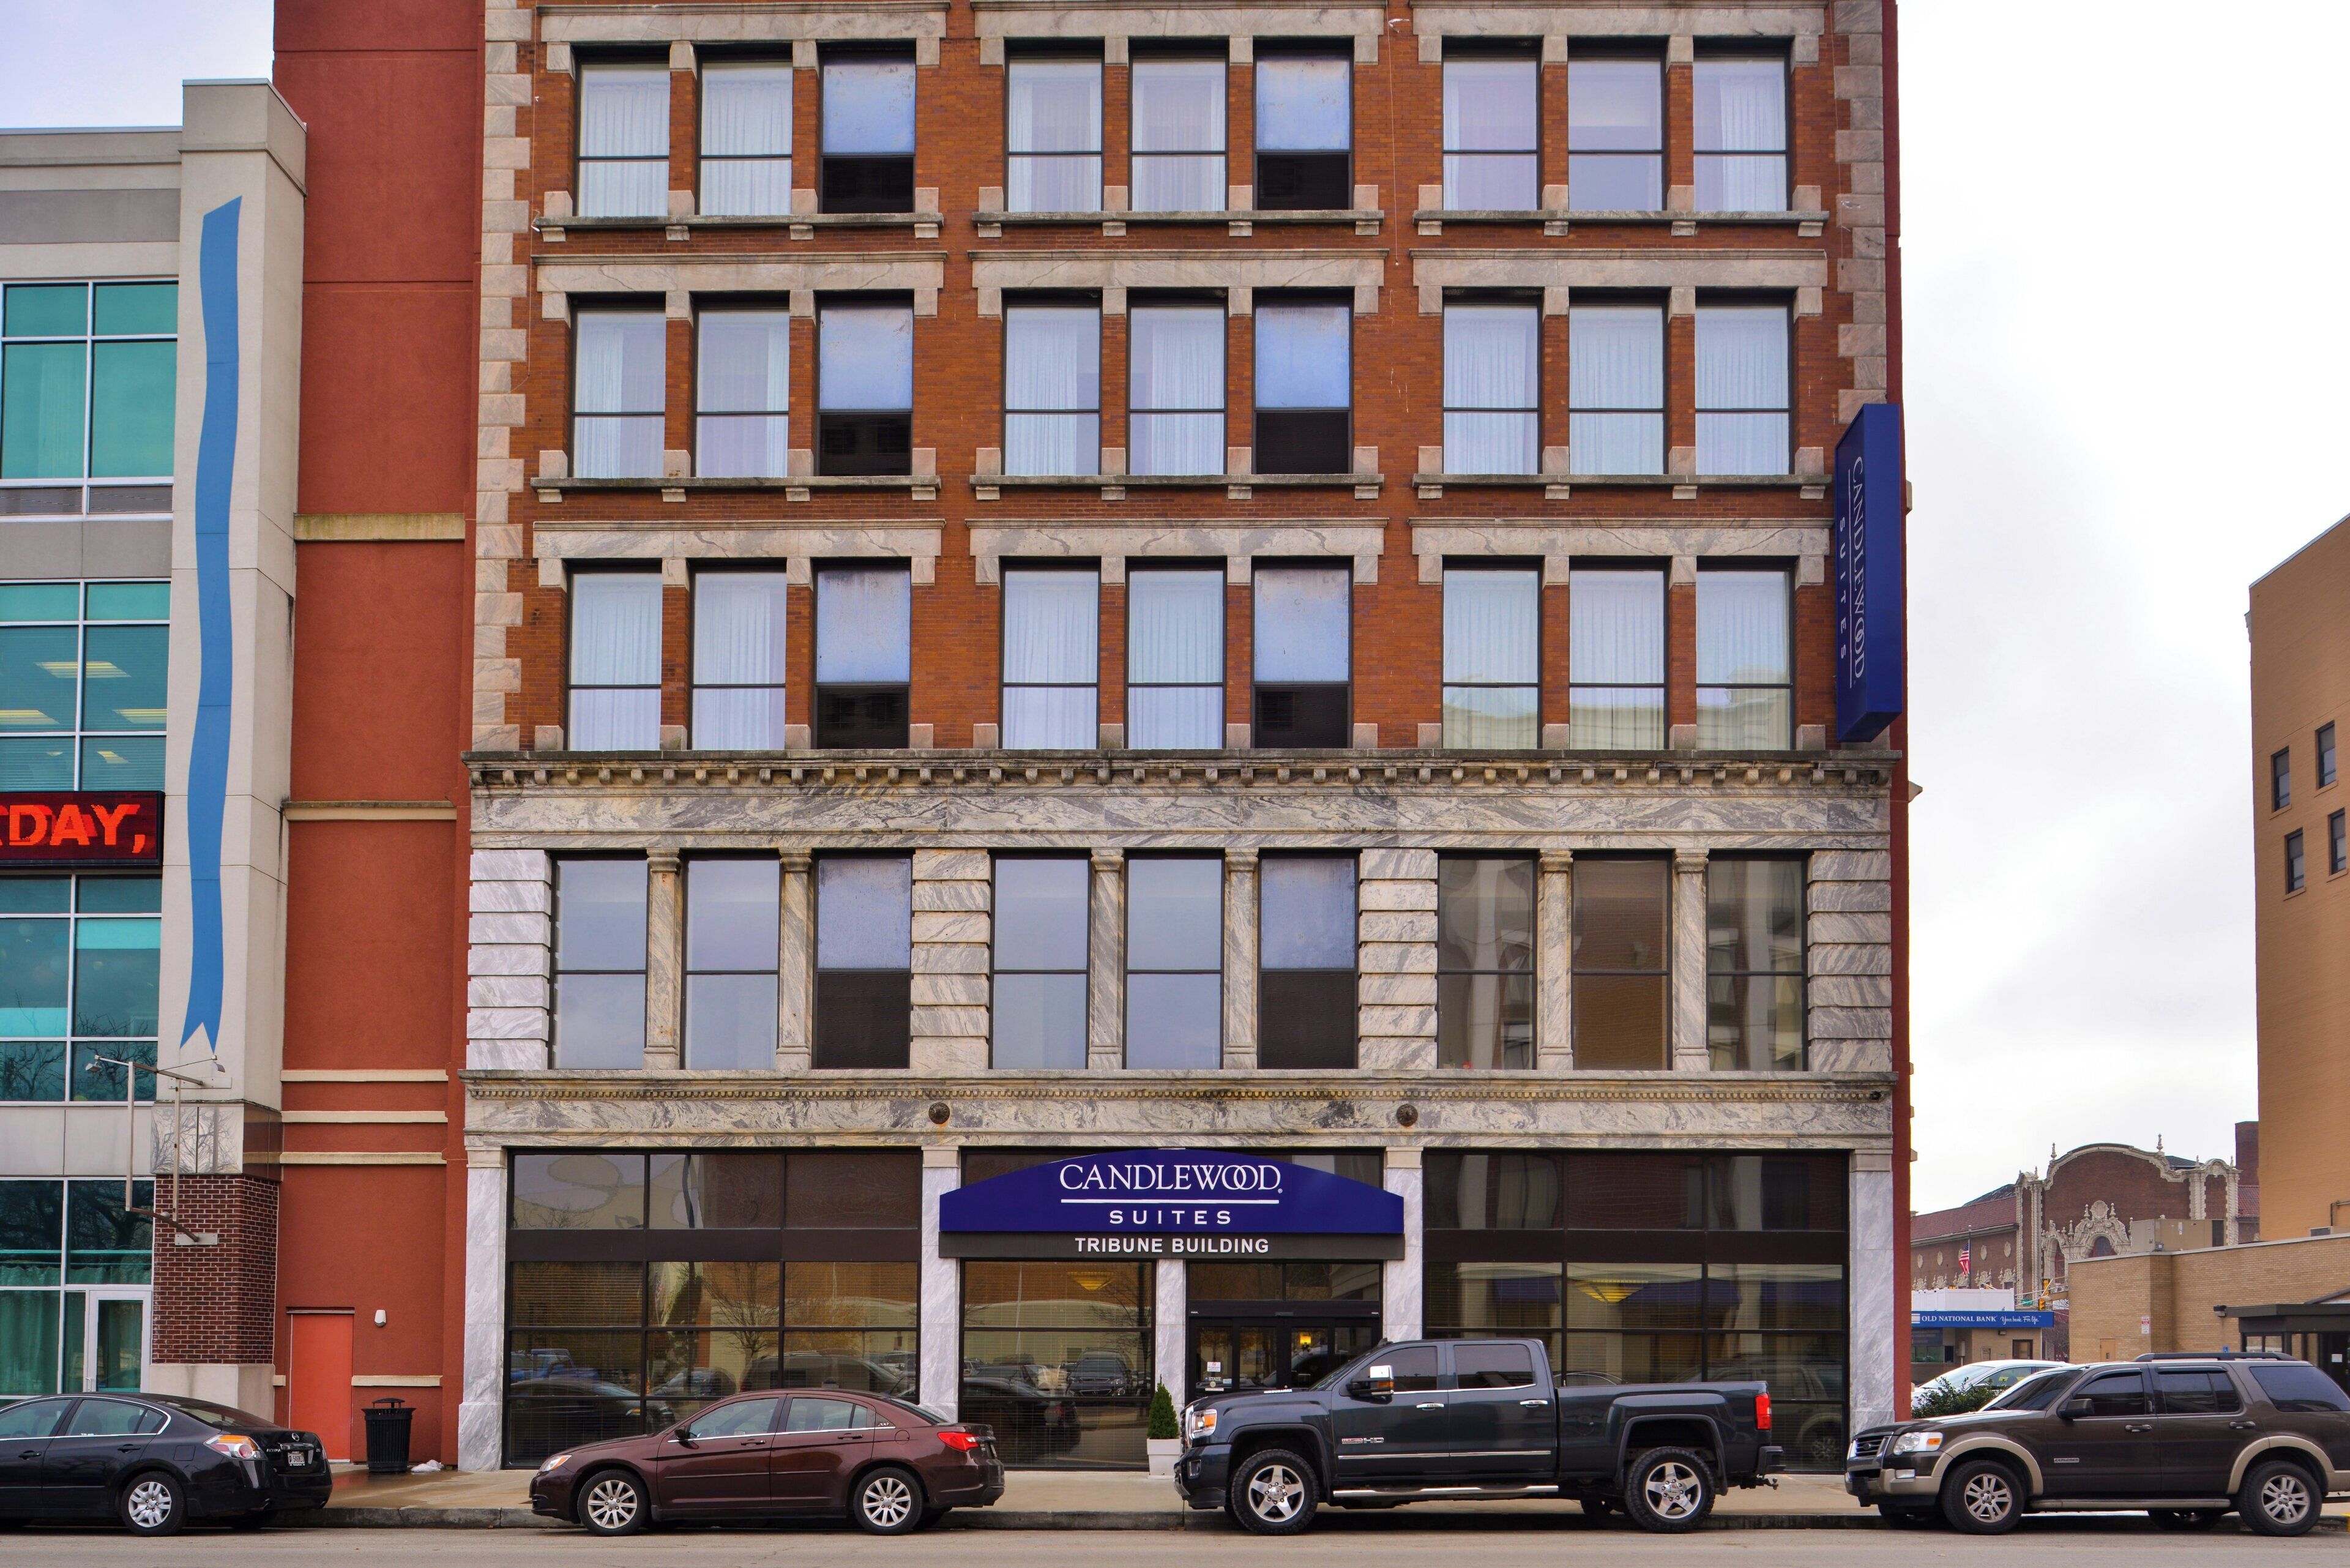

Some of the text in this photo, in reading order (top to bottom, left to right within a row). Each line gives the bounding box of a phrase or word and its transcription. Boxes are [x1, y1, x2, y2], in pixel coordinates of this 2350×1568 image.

[1853, 456, 1865, 678] CANDLEWOOD
[1059, 1164, 1281, 1190] CANDLEWOOD
[1110, 1210, 1231, 1225] SUITES
[1075, 1238, 1269, 1253] TRIBUNE BUILDING
[2000, 1315, 2012, 1325] Your
